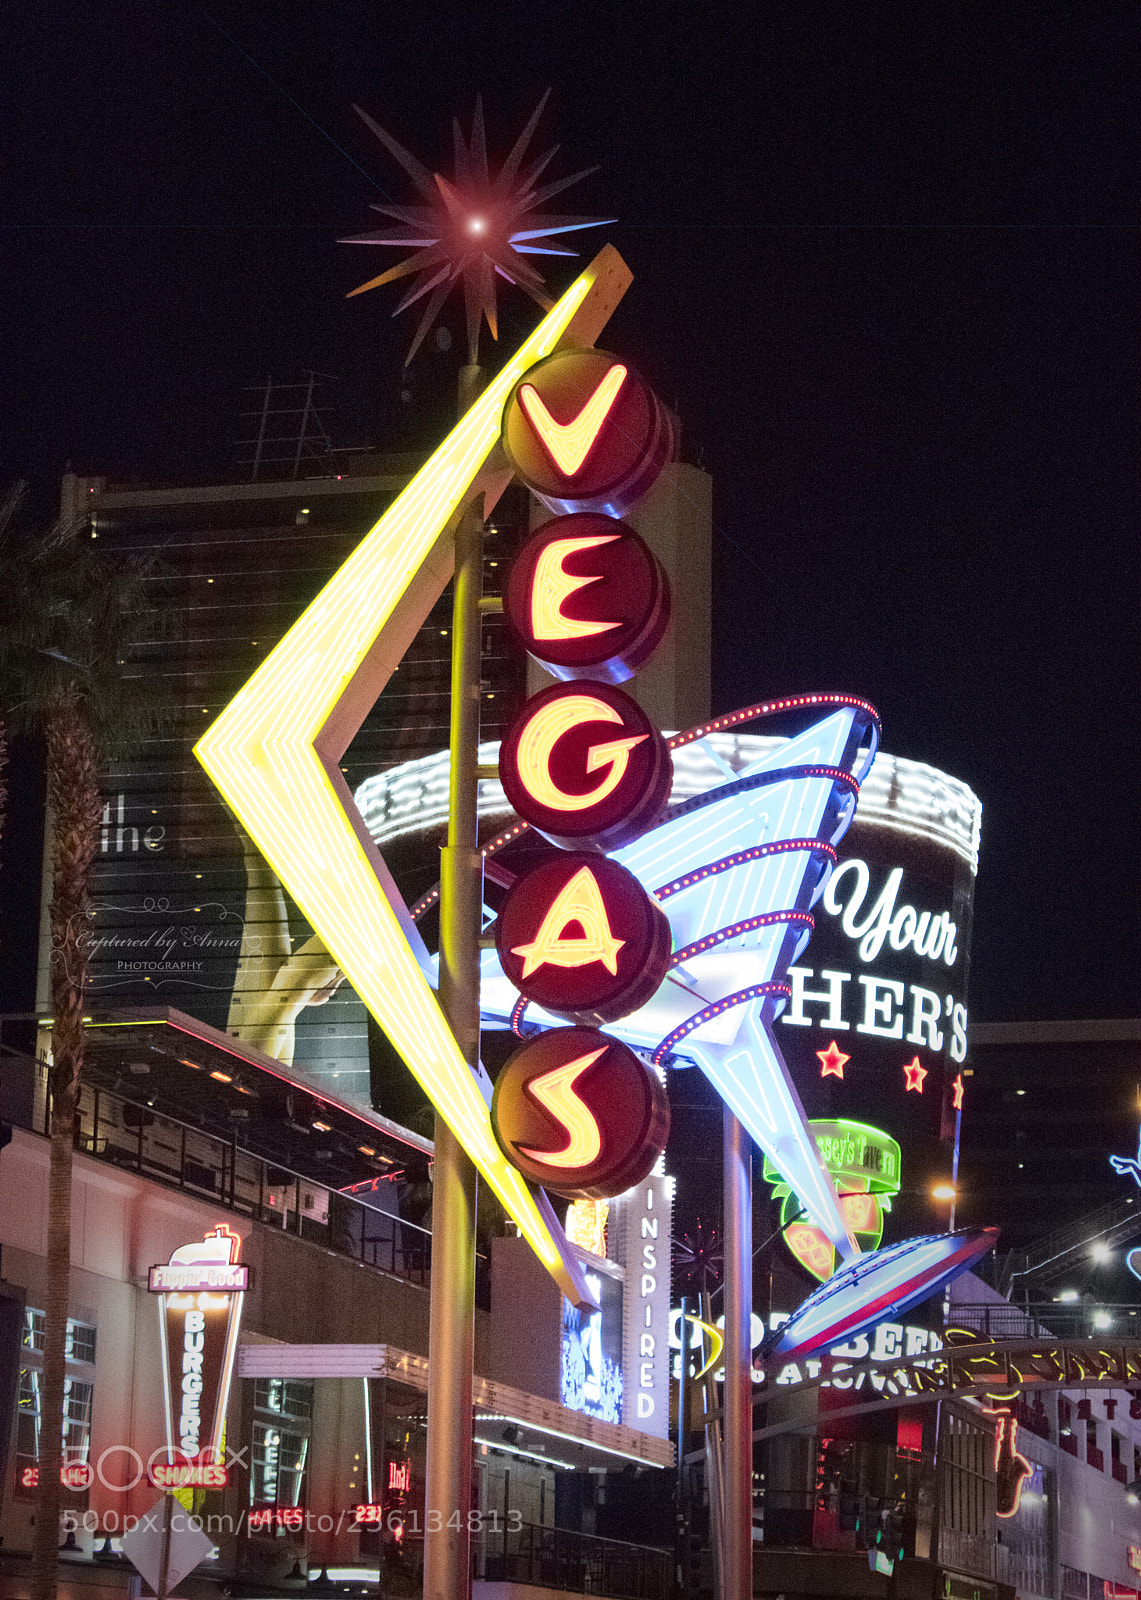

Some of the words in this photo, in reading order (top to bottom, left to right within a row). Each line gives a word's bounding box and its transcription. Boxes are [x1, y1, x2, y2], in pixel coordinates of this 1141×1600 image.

[511, 364, 649, 1168] VEGAS
[823, 859, 958, 966] Your
[207, 1269, 244, 1287] Good
[638, 1188, 658, 1419] INSPIRED
[180, 1311, 205, 1458] BURGERS
[153, 1466, 227, 1486] SHAKES
